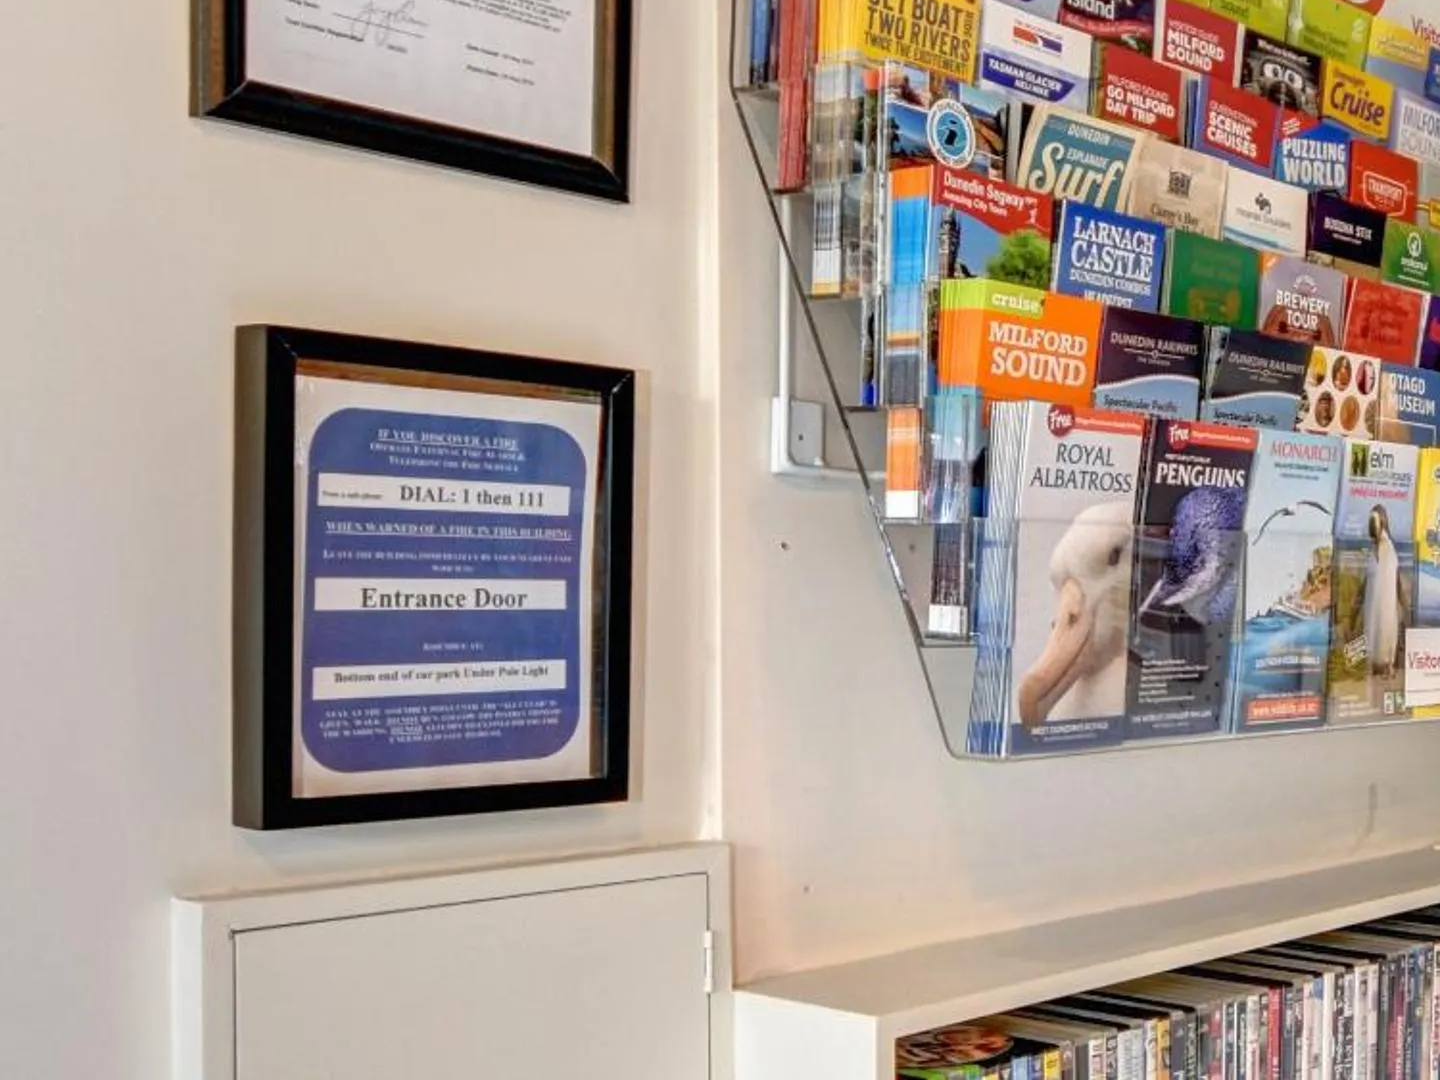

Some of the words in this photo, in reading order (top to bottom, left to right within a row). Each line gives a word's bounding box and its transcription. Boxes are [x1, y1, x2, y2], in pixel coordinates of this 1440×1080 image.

[864, 31, 891, 52] TWICE
[868, 7, 906, 39] TWO
[910, 26, 971, 60] RIVERS
[1167, 30, 1225, 61] MILFORD
[1166, 46, 1212, 71] SOUND
[988, 58, 1026, 81] TASMAN
[1024, 71, 1062, 94] GLACIER
[1106, 101, 1128, 119] DAY
[1132, 109, 1157, 124] TRIP
[1107, 85, 1125, 100] GO
[1126, 90, 1175, 117] MILFORD
[1330, 81, 1385, 127] Cruise
[1067, 122, 1112, 146] DUNEDIN
[1209, 110, 1253, 140] SCENIC
[1206, 126, 1257, 158] CRUISES
[1282, 138, 1346, 160] PUZZLING
[943, 171, 985, 196] Dunedin
[1028, 141, 1125, 209] Surf
[1284, 157, 1346, 187] WORLD
[1073, 216, 1157, 254] LARNACH
[1070, 240, 1154, 281] CASTLE
[992, 292, 1041, 313] cruise
[1275, 289, 1332, 314] BREWERY
[1286, 309, 1319, 331] TOUR
[988, 321, 1088, 357] MILFORD
[1110, 331, 1155, 350] DUNEDIN
[990, 347, 1087, 387] SOUND
[1228, 352, 1268, 368] DUNEDIN
[1391, 373, 1426, 394] OTAGO
[1104, 395, 1150, 412] Spectacular
[1393, 392, 1436, 417] MUSEUM
[1050, 409, 1074, 432] Free
[378, 428, 388, 441] IF
[391, 430, 416, 442] YOU
[421, 432, 480, 447] DISCOVER
[493, 438, 519, 450] FIRE
[1056, 443, 1115, 467] ROYAL
[1272, 441, 1338, 463] MONARCH
[1029, 467, 1133, 493] ALBATROSS
[1156, 462, 1245, 488] PENGUINS
[400, 485, 456, 503] DIAL:
[463, 489, 470, 504] 1
[476, 489, 512, 505] then
[518, 491, 544, 507] 111
[326, 521, 362, 533] WHEN
[365, 522, 419, 534] WARNED
[449, 525, 475, 537] FIRE
[360, 587, 466, 609] Entrance
[475, 587, 528, 609] Door
[334, 672, 374, 683] Bottom
[380, 672, 399, 682] end
[401, 670, 413, 681] of
[416, 670, 433, 680] car
